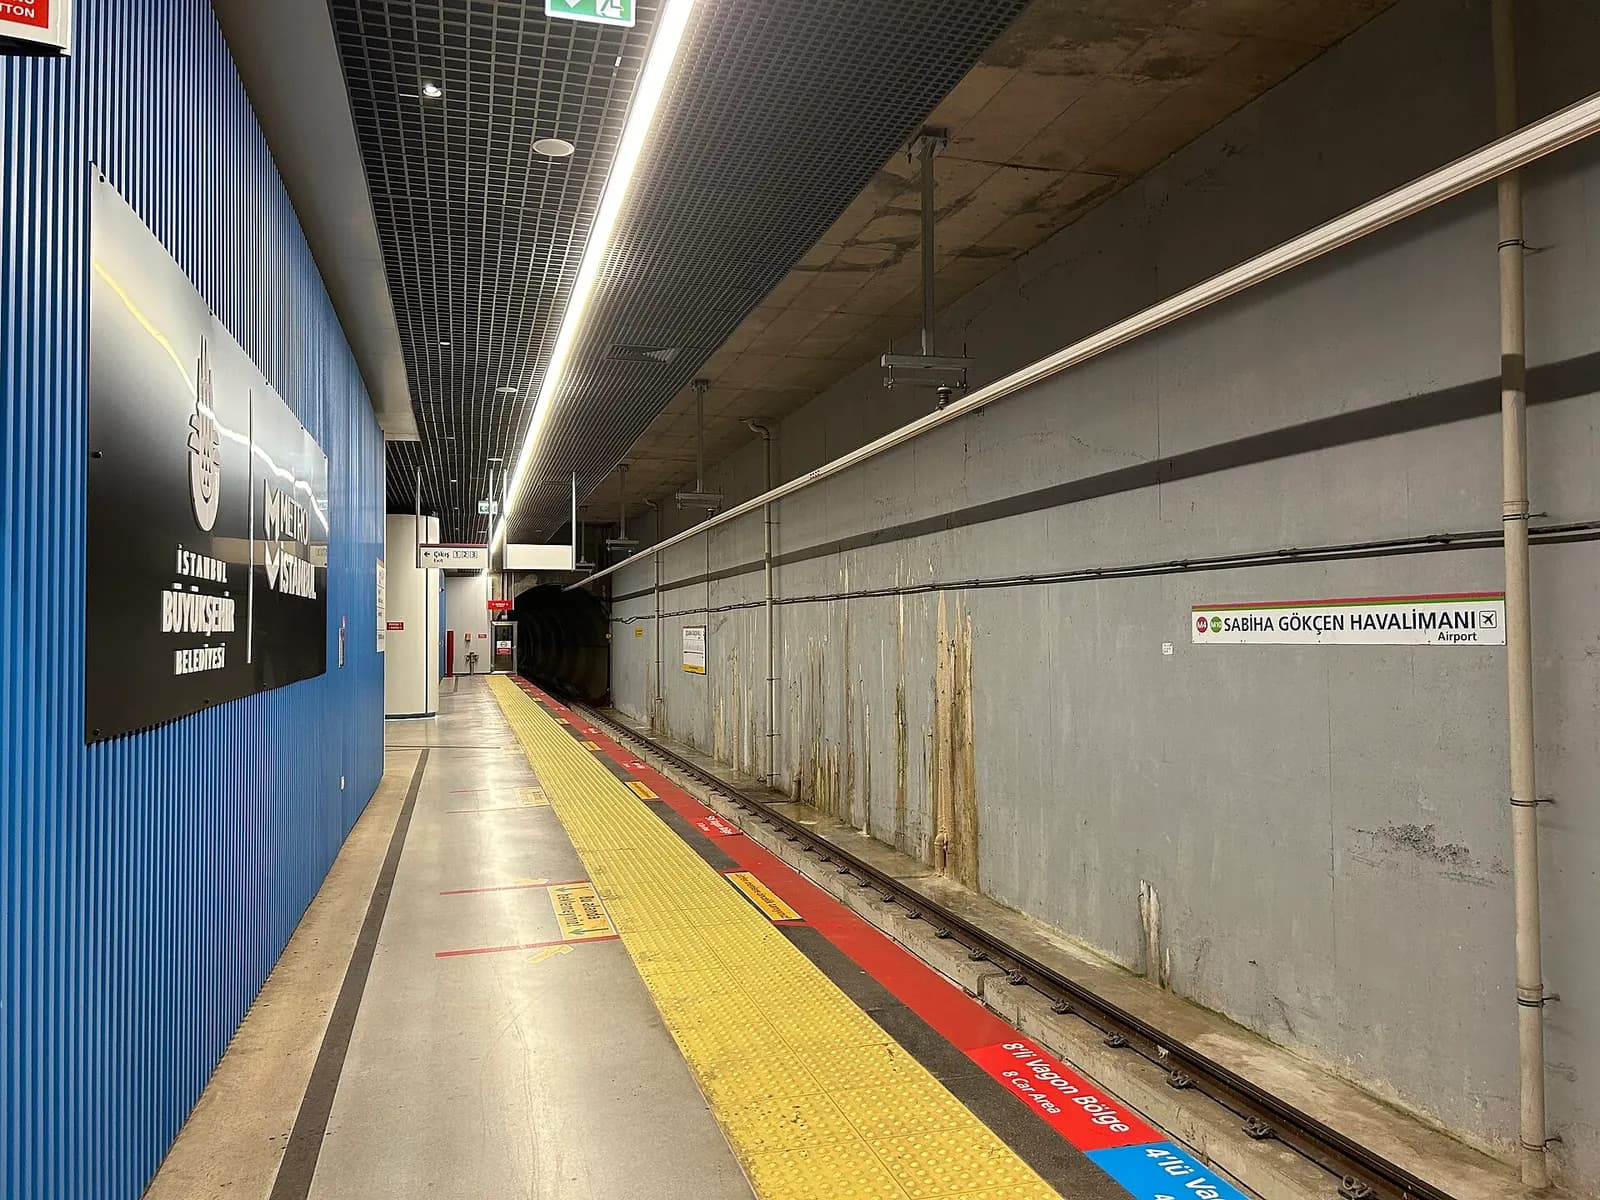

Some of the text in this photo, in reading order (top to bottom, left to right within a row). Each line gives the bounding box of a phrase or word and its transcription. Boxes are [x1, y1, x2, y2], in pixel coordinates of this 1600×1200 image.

[280, 490, 309, 546] METRO
[176, 543, 228, 583] İSTANBUL
[161, 582, 236, 637] BÜYÜKŞEHİR
[1224, 613, 1275, 632] SABİHA
[1279, 612, 1344, 635] GÖKÇEN
[1350, 608, 1475, 631] HAVALİMANI
[174, 642, 226, 675] BELEDİYESİ
[1437, 631, 1478, 643] Airport
[1002, 1042, 1131, 1133] 8'li Vagon Bölge
[1002, 1070, 1061, 1114] 8 Car Area
[1144, 1148, 1226, 1200] 4'lü Va
